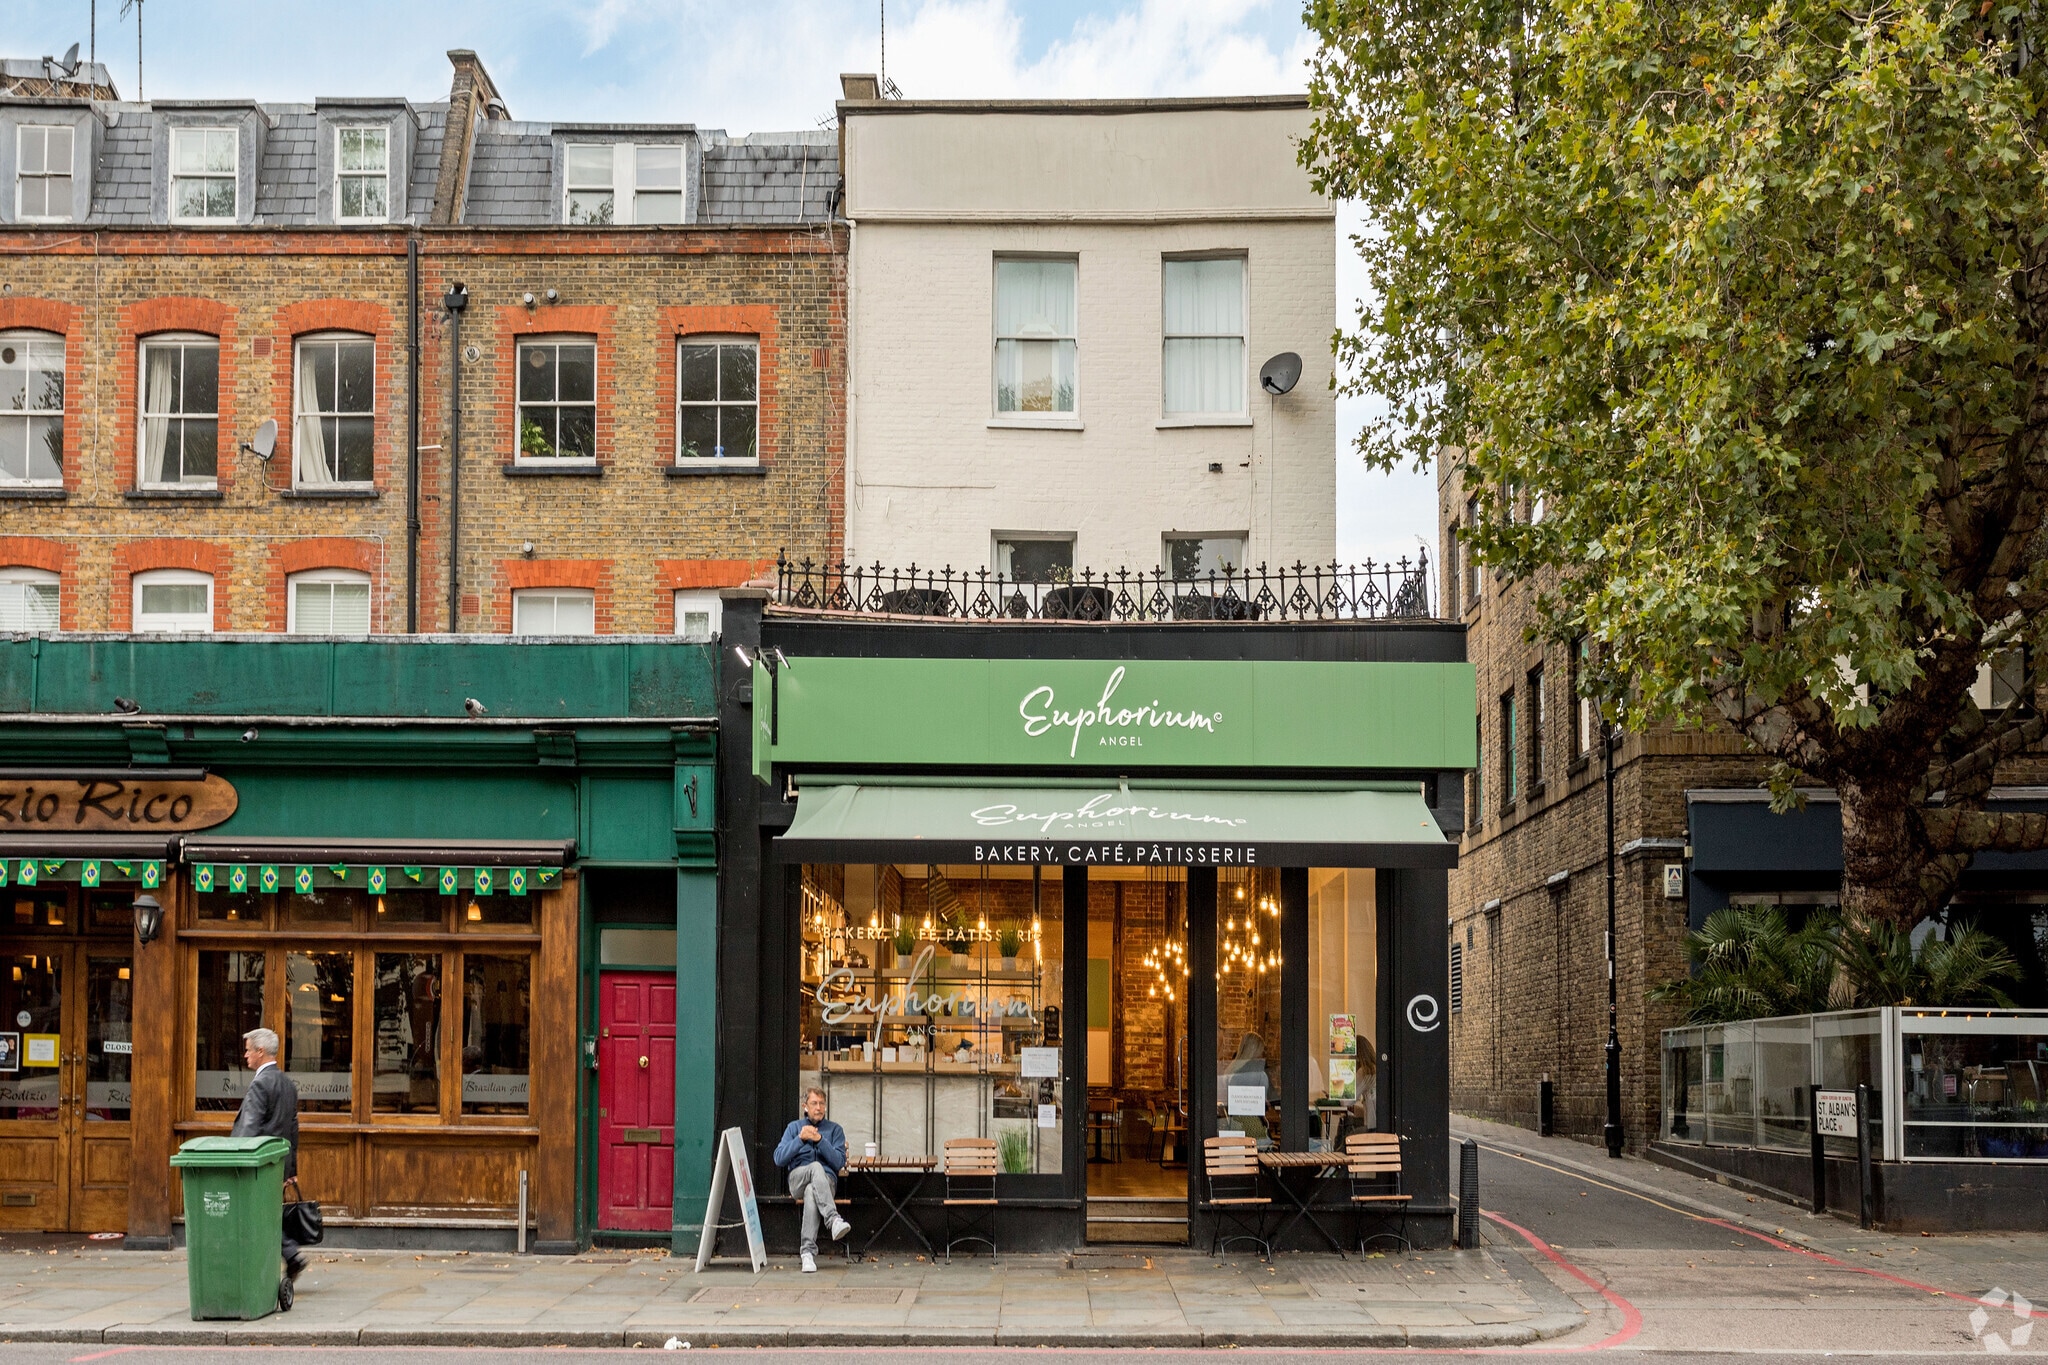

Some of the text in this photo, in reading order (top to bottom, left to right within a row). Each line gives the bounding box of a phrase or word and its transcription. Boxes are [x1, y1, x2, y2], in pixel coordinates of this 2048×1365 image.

[1019, 665, 1215, 758] Euphorium
[1099, 736, 1143, 746] ANGEL
[75, 780, 193, 824] Rico
[970, 793, 1237, 832] Euphorium
[1064, 819, 1126, 829] ANGEL
[974, 845, 1059, 863] BAKERY,
[823, 926, 888, 942] BAKERY,
[946, 925, 1043, 942] PÂTISSRIE
[815, 944, 1037, 1049] Euphorium
[905, 1024, 955, 1036] ANGEL
[0, 1087, 47, 1101] Rodizio
[465, 1081, 527, 1096] Brazilian grill
[1818, 1101, 1857, 1118] ST. ALBAN'S
[1819, 1116, 1838, 1132] PLACE
